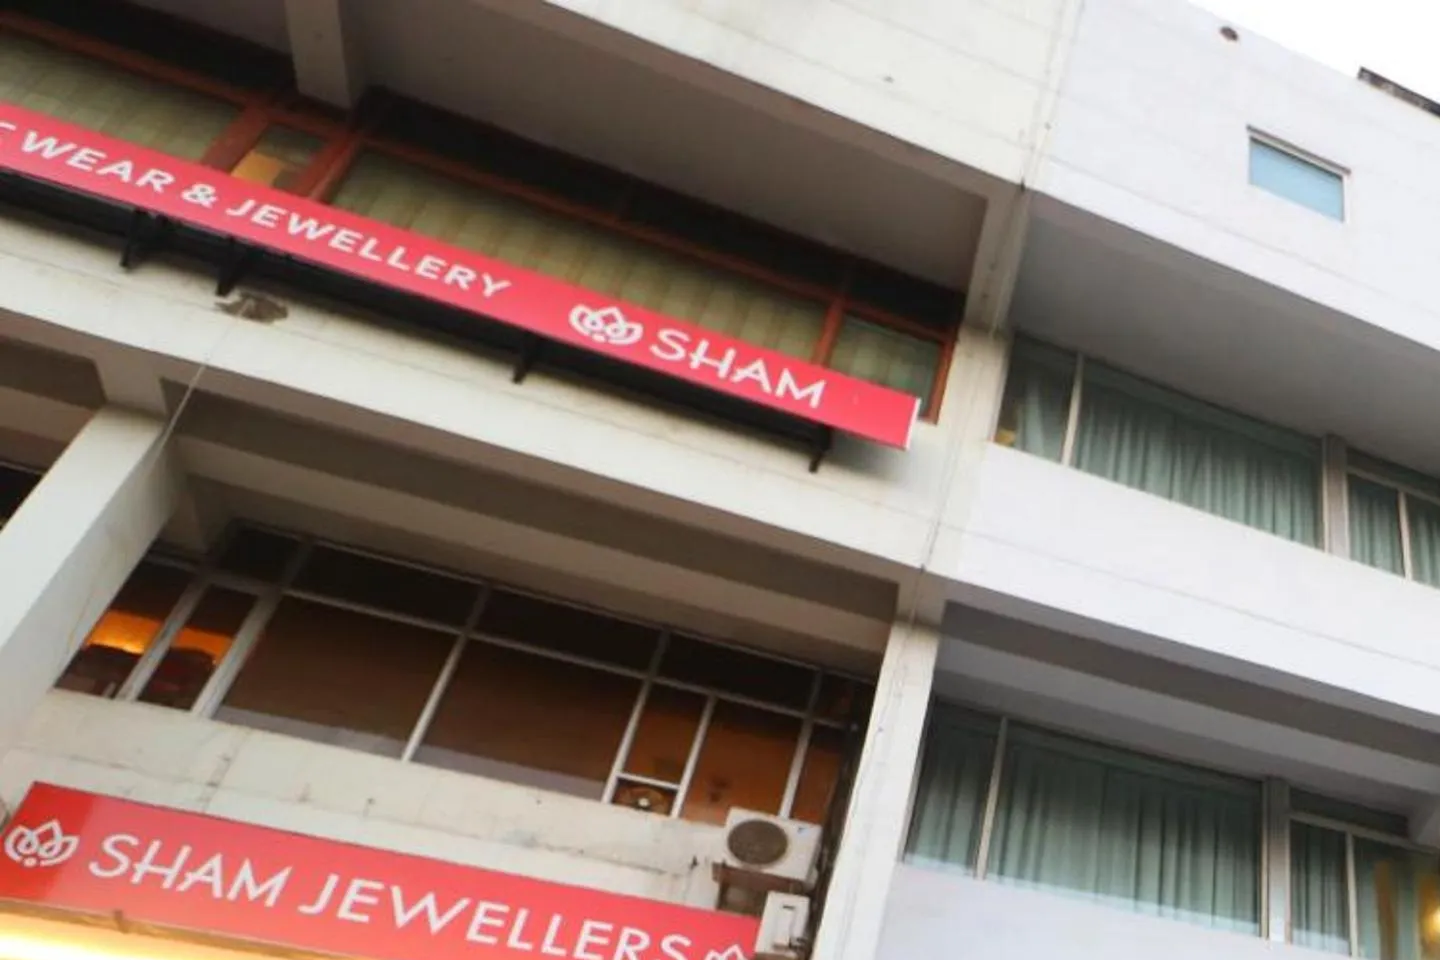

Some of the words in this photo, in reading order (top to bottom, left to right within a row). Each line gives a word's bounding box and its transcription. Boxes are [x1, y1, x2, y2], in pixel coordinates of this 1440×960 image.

[23, 130, 174, 194] WEAR
[182, 183, 218, 209] &
[227, 199, 511, 298] JEWELLERY
[650, 329, 826, 408] SHAM
[89, 833, 292, 908] SHAM
